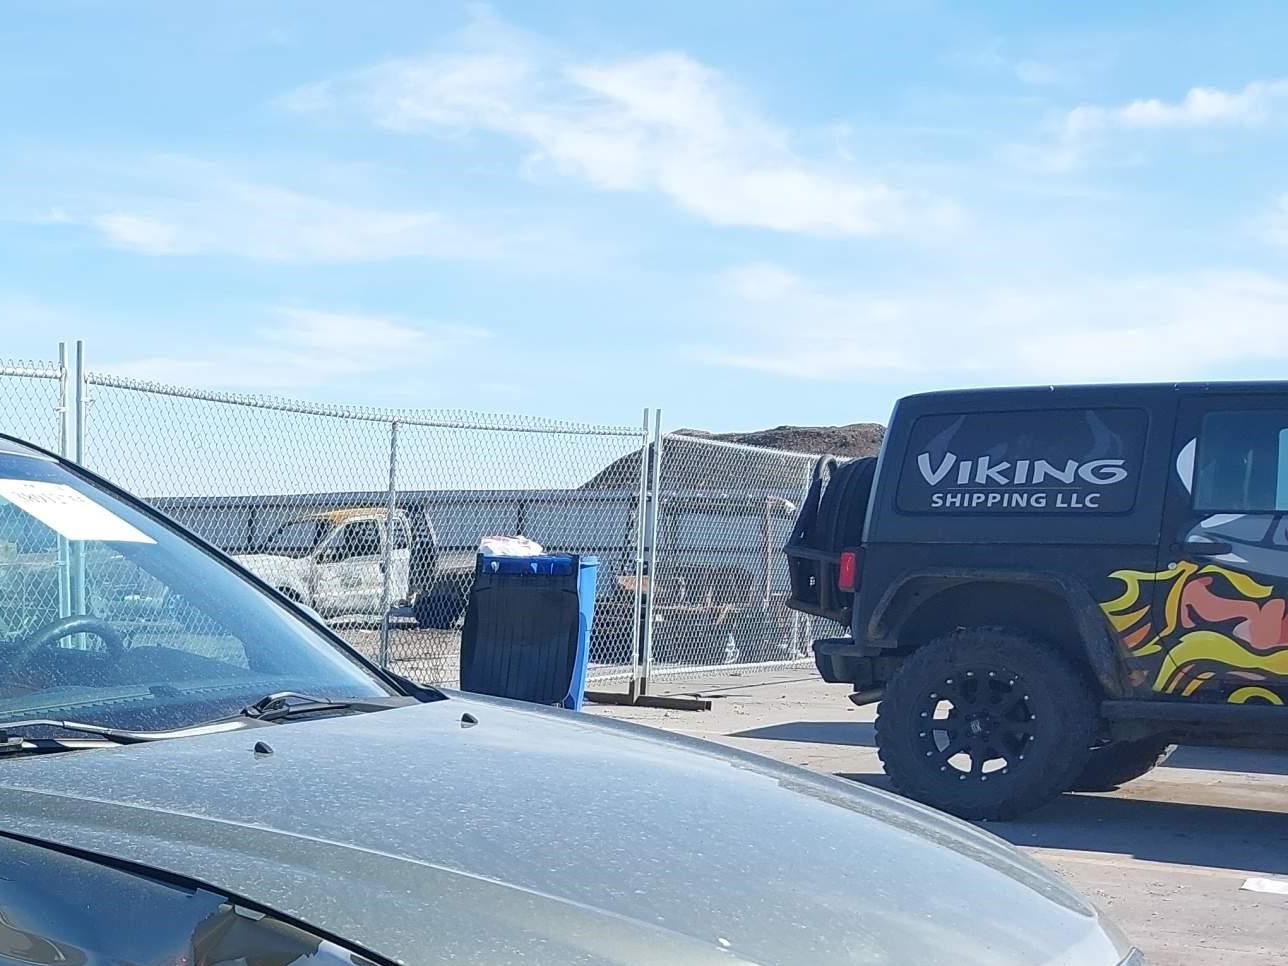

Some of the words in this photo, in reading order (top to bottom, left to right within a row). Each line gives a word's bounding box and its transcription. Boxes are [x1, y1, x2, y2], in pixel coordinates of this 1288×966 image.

[917, 452, 1128, 486] VIKING
[931, 493, 1047, 508] SHIPPING
[1055, 493, 1101, 508] LLC
